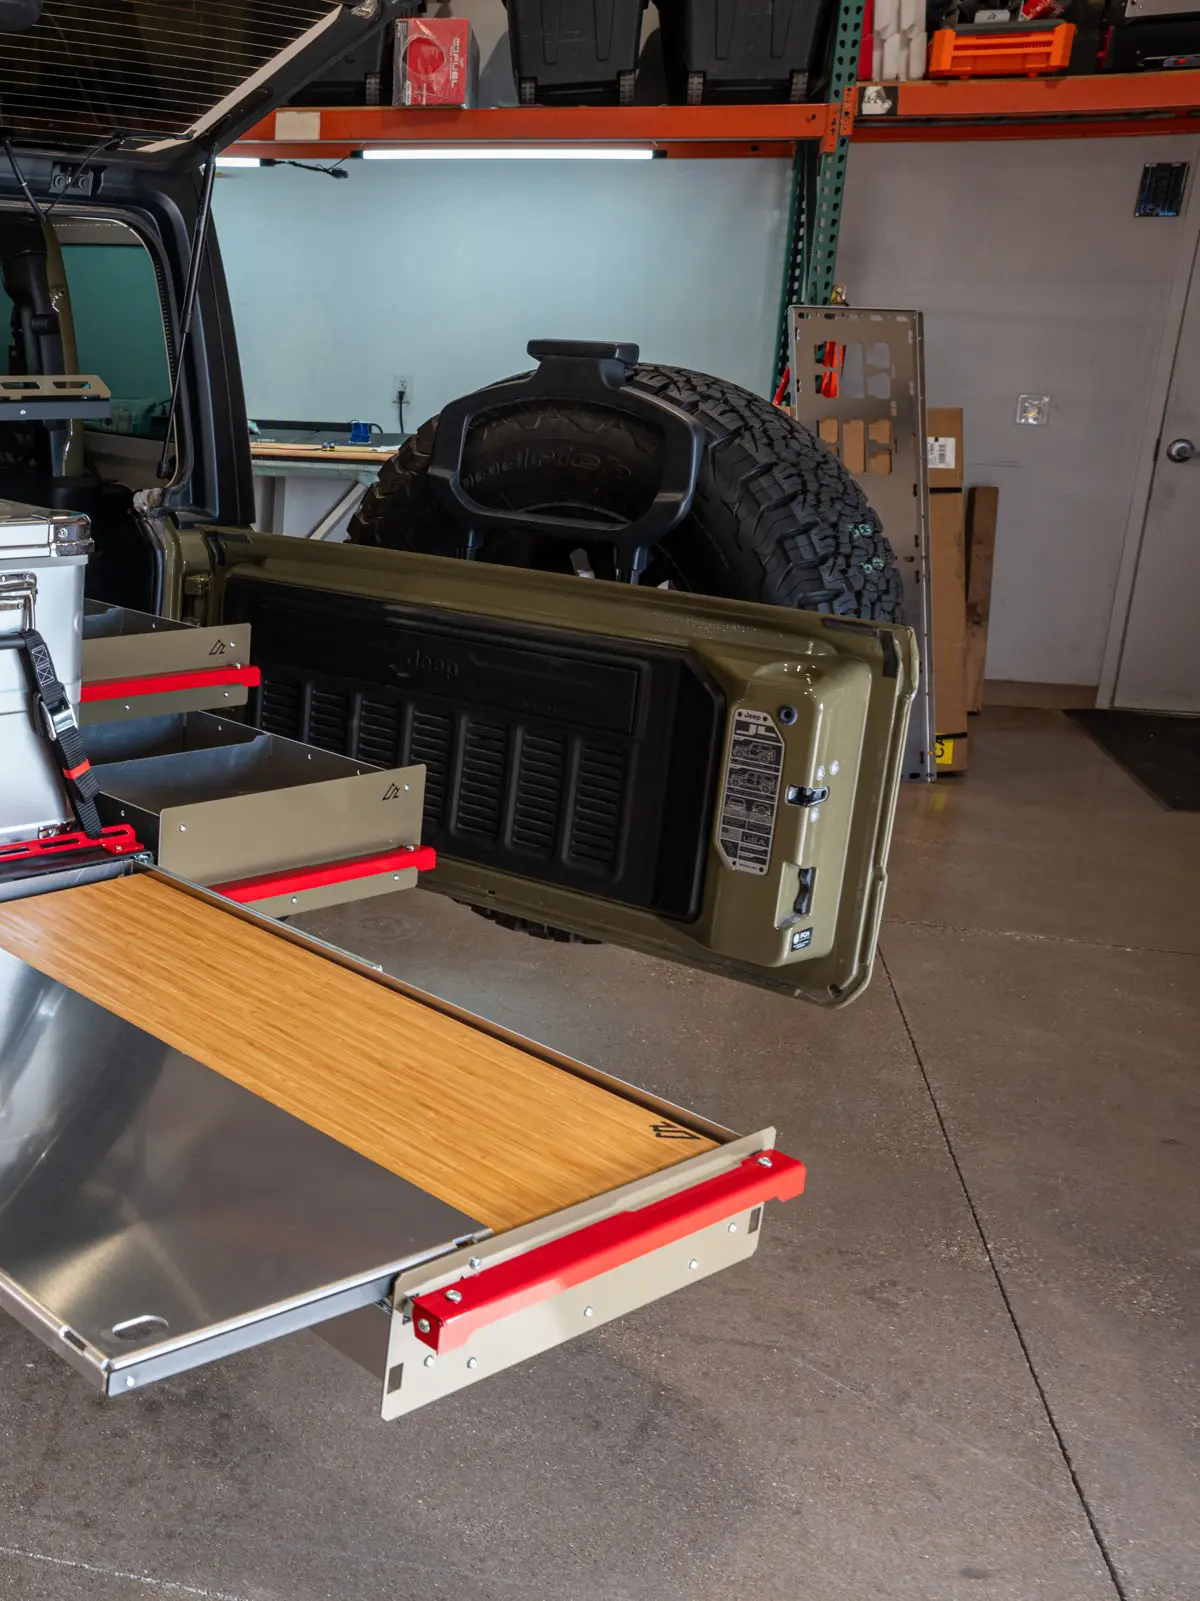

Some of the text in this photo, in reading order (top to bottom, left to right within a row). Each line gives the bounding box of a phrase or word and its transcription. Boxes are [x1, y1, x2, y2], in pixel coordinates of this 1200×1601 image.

[451, 53, 459, 88] FUEL
[744, 712, 761, 721] Jeep
[735, 724, 777, 737] JL
